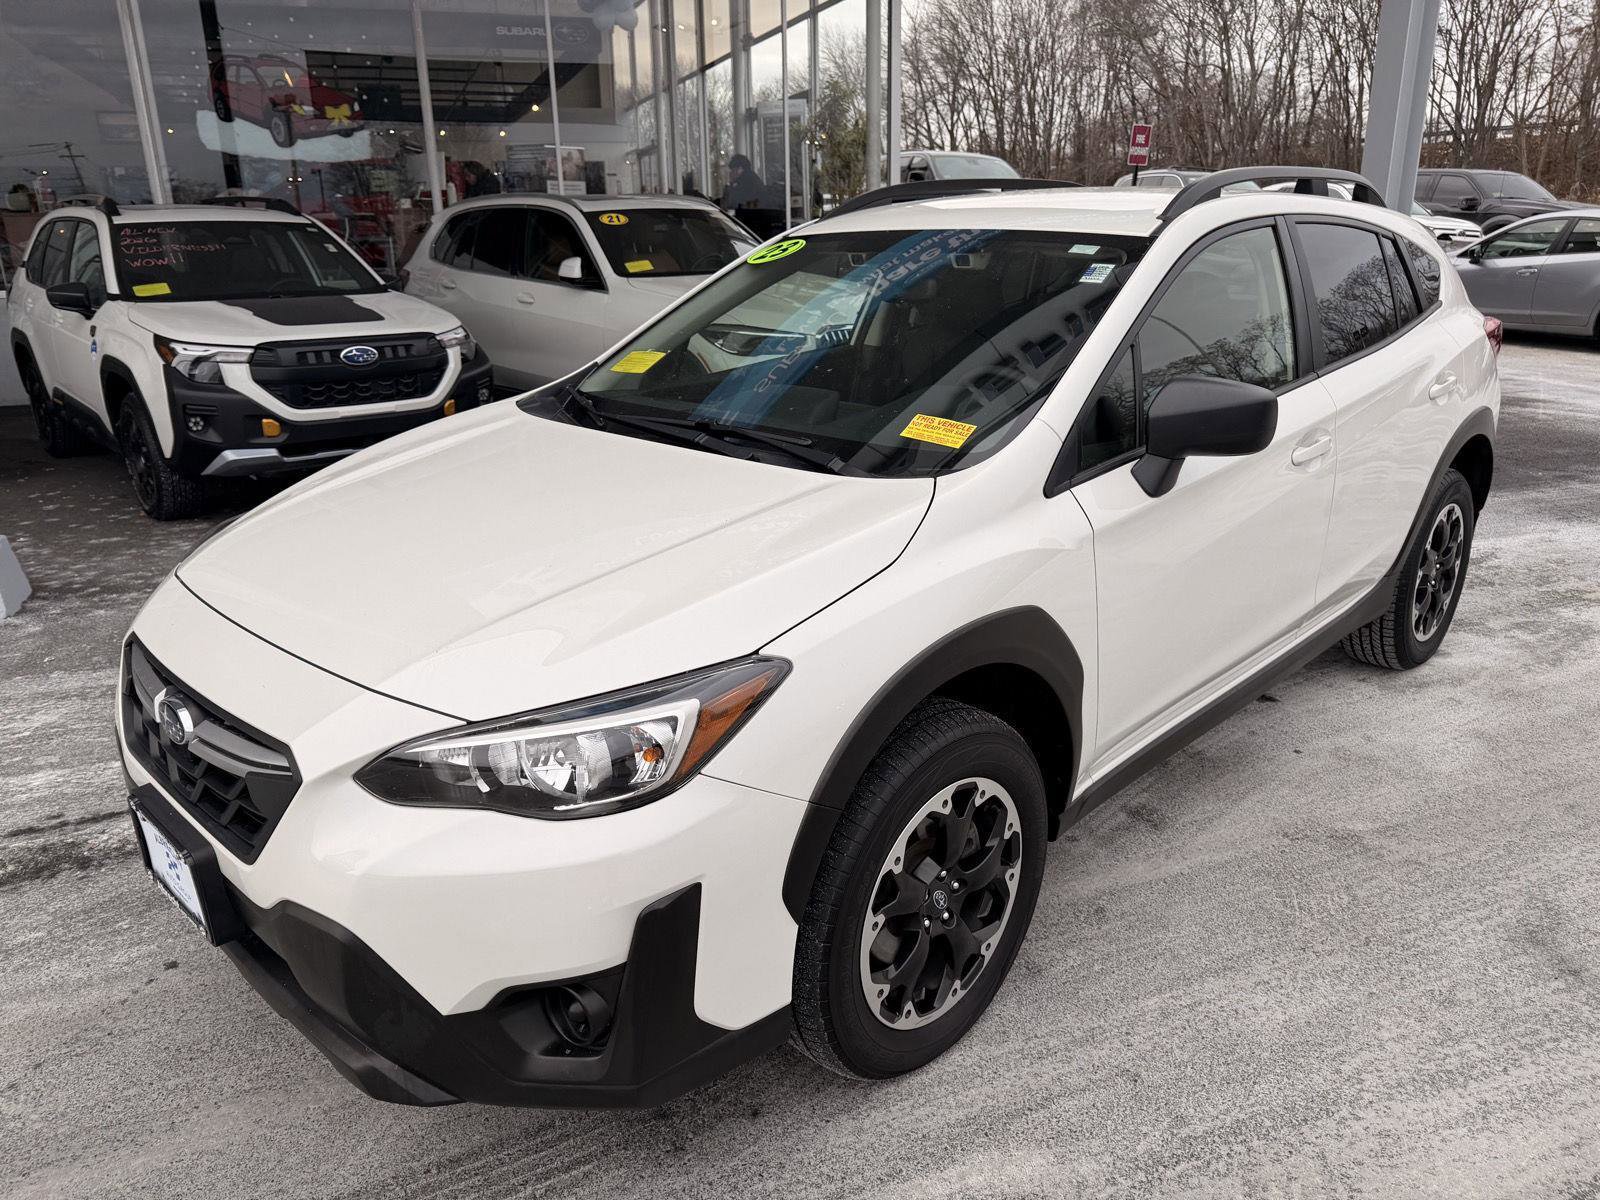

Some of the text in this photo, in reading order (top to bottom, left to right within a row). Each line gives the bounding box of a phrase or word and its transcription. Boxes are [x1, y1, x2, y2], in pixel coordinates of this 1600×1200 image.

[496, 26, 547, 36] SUBARU
[606, 215, 621, 223] 21
[752, 240, 800, 261] 23
[911, 420, 922, 428] NOT
[924, 423, 941, 431] READY
[954, 430, 970, 438] SALE
[916, 415, 936, 425] THIS
[938, 419, 975, 433] VEHICLE
